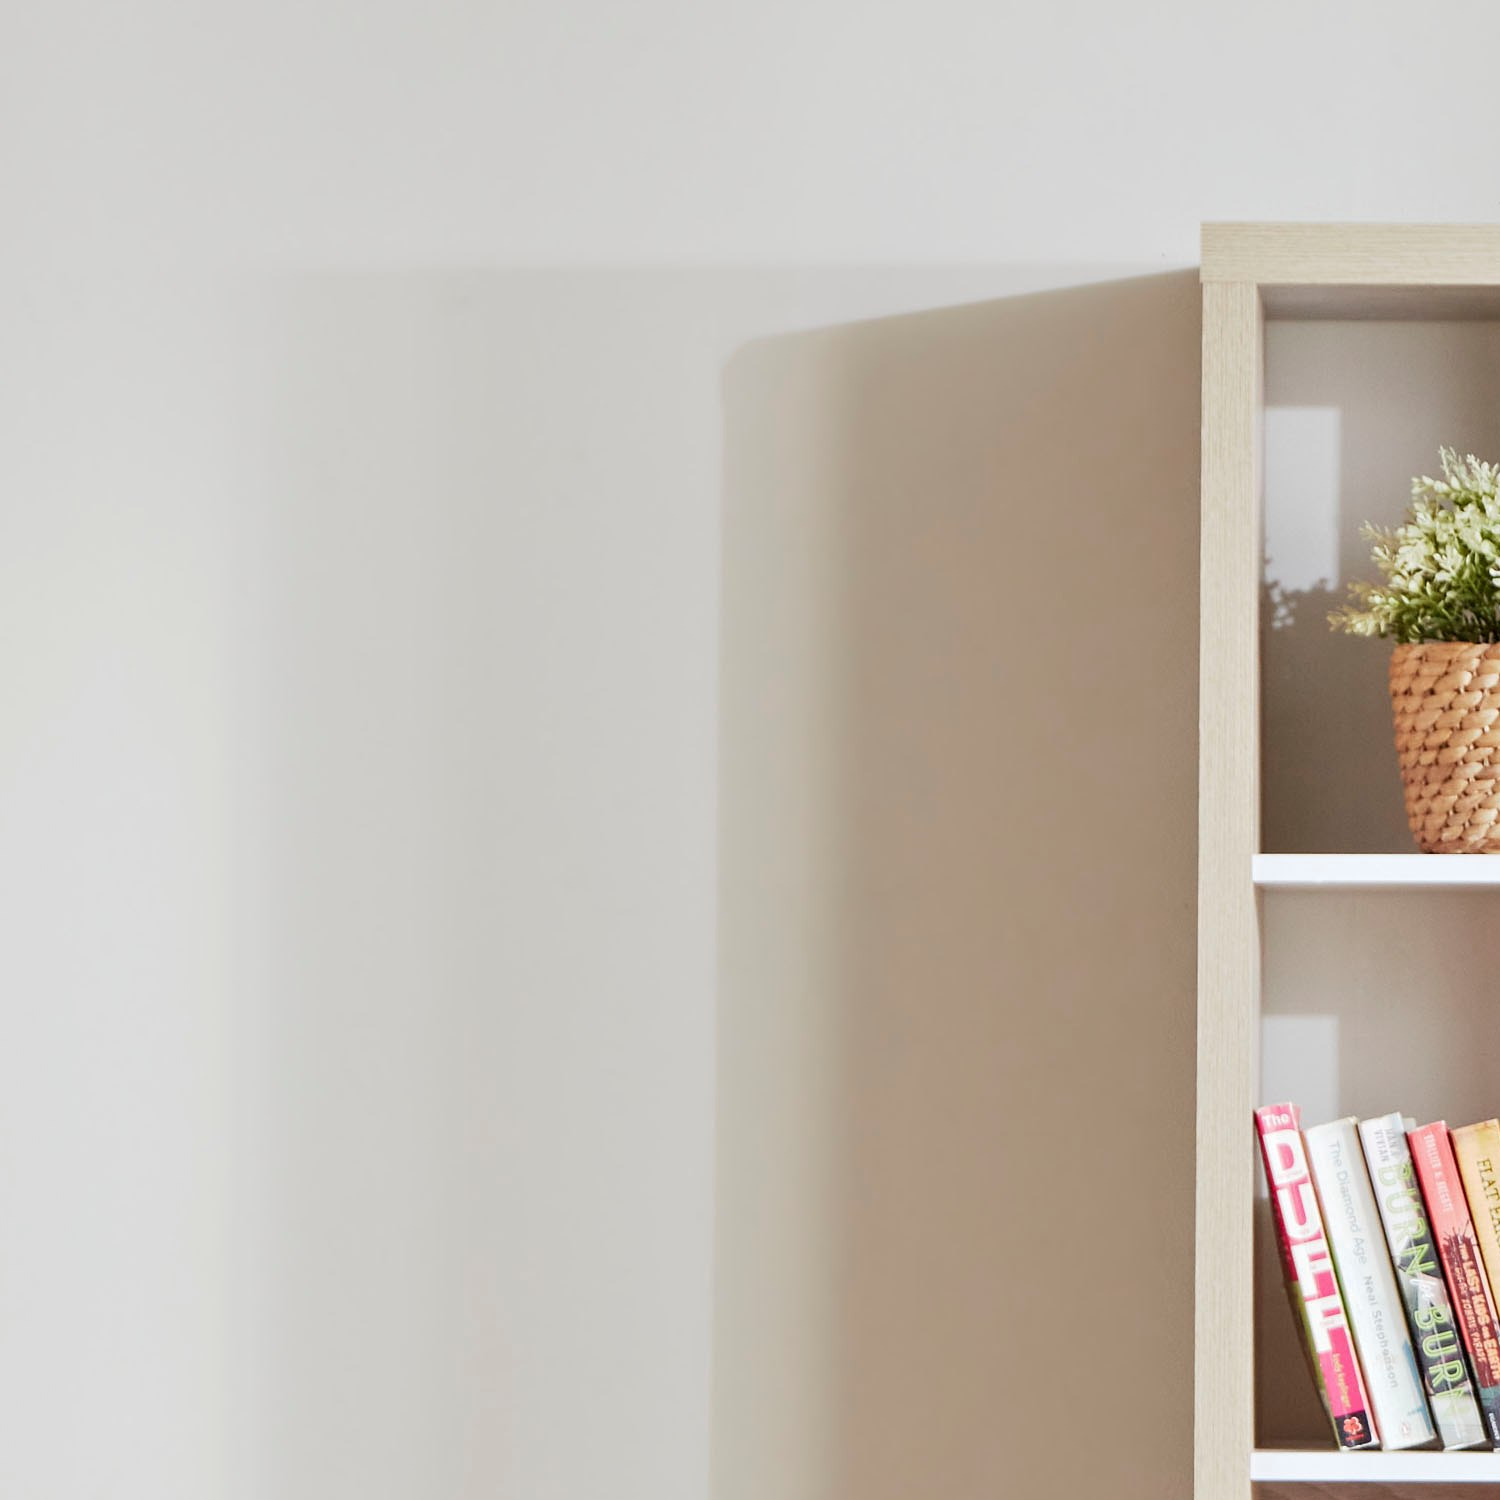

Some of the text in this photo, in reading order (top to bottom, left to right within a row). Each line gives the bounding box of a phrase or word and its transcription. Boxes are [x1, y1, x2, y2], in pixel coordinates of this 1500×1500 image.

[1262, 1113, 1290, 1127] The
[1328, 1140, 1369, 1265] The Diamond Age
[1476, 1158, 1499, 1202] FLAT
[1262, 1129, 1344, 1352] DUFF
[1379, 1162, 1433, 1275] BURN
[1407, 1274, 1438, 1302] for
[1462, 1260, 1480, 1293] LAST
[1362, 1275, 1399, 1387] Neal Stephenson
[1461, 1297, 1477, 1328] ZOMBIE
[1470, 1331, 1486, 1362] PARADE
